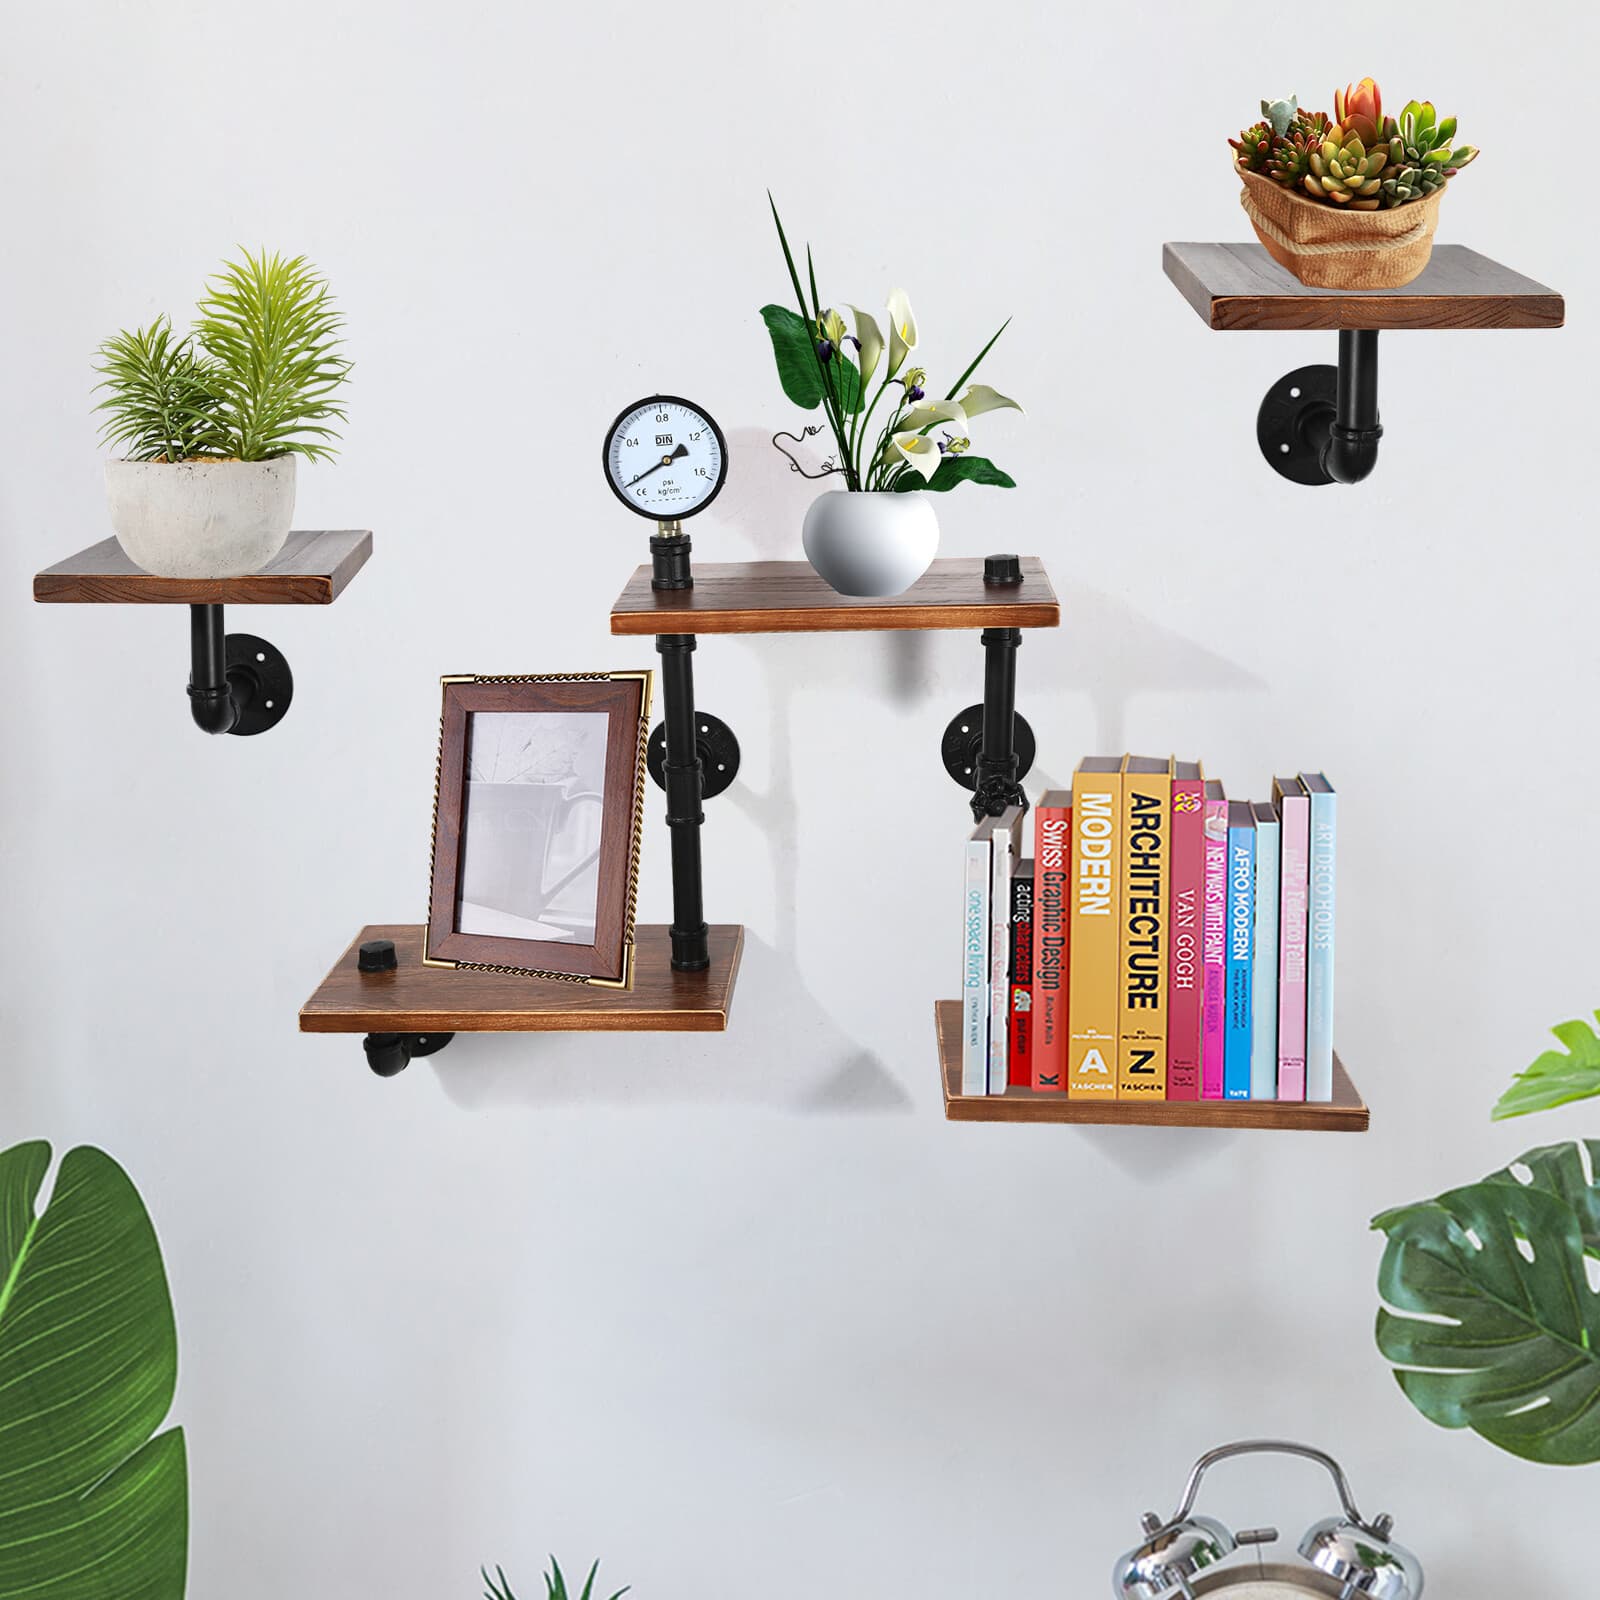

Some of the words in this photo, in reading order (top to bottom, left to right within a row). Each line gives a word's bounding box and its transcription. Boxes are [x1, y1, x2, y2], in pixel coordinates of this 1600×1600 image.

[655, 435, 673, 445] DIN
[1042, 820, 1068, 868] Swiss
[1079, 793, 1112, 915] MODERN
[1316, 823, 1334, 849] ART
[1206, 846, 1224, 871] NEW
[1234, 846, 1250, 890] AFRO
[1315, 854, 1333, 896] DECO
[969, 889, 982, 915] one
[1038, 872, 1067, 933] Graphic
[1128, 791, 1162, 1009] ARCHITECTURE
[1205, 872, 1224, 902] WAYS
[1177, 890, 1196, 928] VAN
[1205, 903, 1223, 931] WITH
[1233, 893, 1250, 961] MODERN
[1314, 900, 1332, 950] HOUSE
[966, 917, 983, 952] space
[1204, 932, 1223, 965] PAINT
[965, 953, 985, 989] living
[1036, 936, 1066, 991] Design
[1176, 934, 1196, 989] GOGH
[1286, 944, 1305, 982] Fellini
[1039, 1073, 1060, 1085] K
[1078, 1049, 1108, 1074] A
[1129, 1050, 1155, 1074] Z
[1121, 1083, 1163, 1091] TASCHEN
